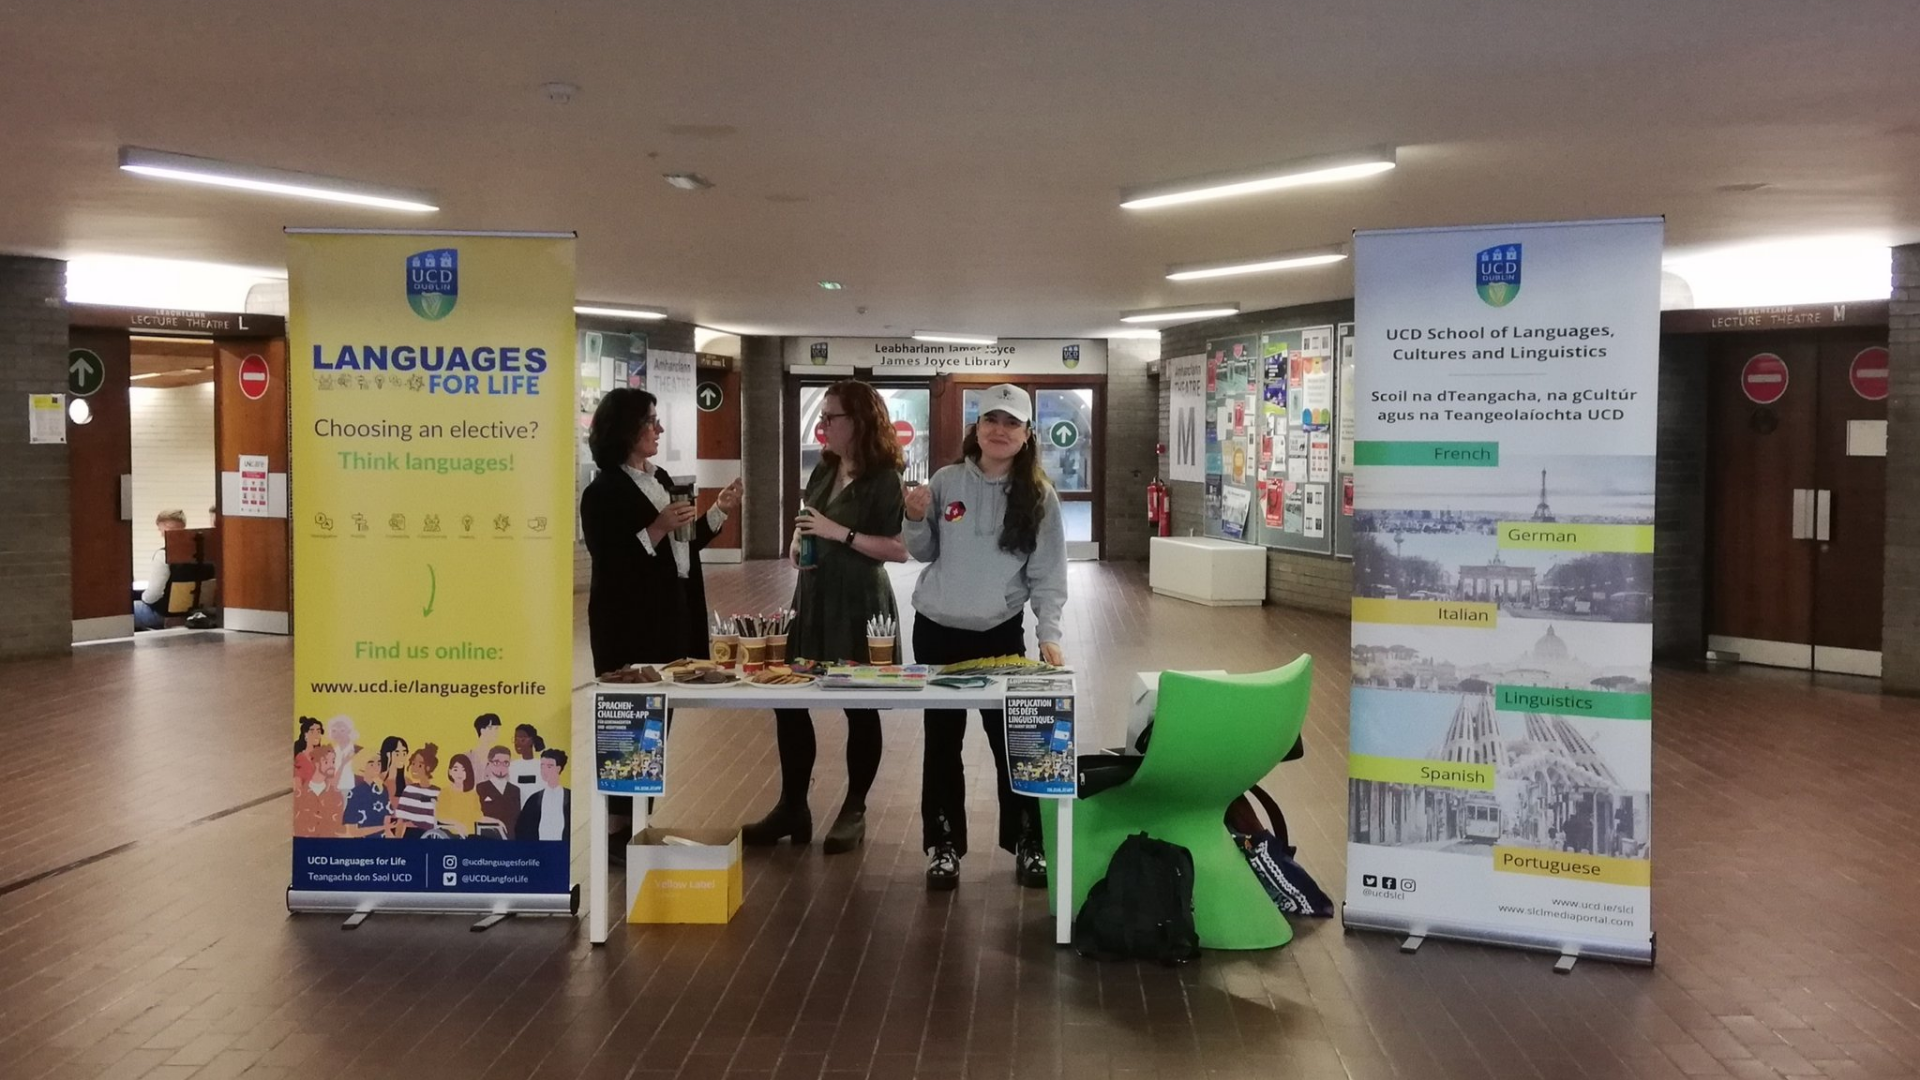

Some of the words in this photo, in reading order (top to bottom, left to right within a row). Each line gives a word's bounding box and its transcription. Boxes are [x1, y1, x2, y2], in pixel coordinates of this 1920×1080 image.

[1481, 262, 1517, 274] UCD
[412, 269, 452, 283] UCD
[131, 315, 178, 326] LECTURE
[186, 318, 230, 330] THEATRE
[238, 316, 249, 330] L
[1712, 316, 1761, 328] LECTURE
[1770, 313, 1821, 325] THEATRE
[1833, 305, 1845, 322] M
[1386, 329, 1422, 340] UCD
[1427, 328, 1485, 340] School
[1490, 327, 1508, 339] of
[1513, 326, 1615, 342] Languages,
[875, 344, 944, 354] Leabharlann
[1393, 348, 1466, 360] Cultures
[1472, 347, 1505, 360] and
[1511, 346, 1607, 362] Linguistics
[313, 345, 547, 373] LANGUAGES
[880, 356, 920, 366] James
[924, 356, 960, 368] Joyce
[964, 356, 1011, 368] Library
[429, 374, 479, 394] FOR
[488, 375, 540, 395] LIFE
[1371, 390, 1407, 402] Scoil
[1413, 392, 1432, 402] na
[1437, 390, 1541, 404] dTeangacha,
[1547, 391, 1567, 401] na
[1573, 388, 1637, 404] gCultúr
[1378, 411, 1415, 423] agus
[1420, 411, 1439, 421] na
[1445, 409, 1582, 423] Teangeolaíochta
[1588, 409, 1624, 420] UCD
[314, 419, 413, 441] Choosing
[419, 425, 443, 438] an
[450, 420, 539, 439] elective?
[1176, 407, 1195, 466] M
[1434, 447, 1491, 461] French
[338, 451, 400, 470] Think
[406, 453, 514, 474] languages!
[1508, 528, 1577, 543] German
[1438, 608, 1489, 622] Italian
[355, 641, 400, 659] Find
[407, 645, 429, 659] us
[435, 642, 503, 660] online:
[311, 680, 546, 698] www.ucd.ie/languagesforlife
[597, 701, 634, 710] SPRACHEN-
[1504, 692, 1593, 710] Linguistics
[597, 710, 650, 719] CHALLENGE-APP
[1008, 715, 1055, 724] LINGUISTIQUES
[1420, 766, 1486, 784] Spanish
[307, 856, 328, 866] UCD
[329, 857, 375, 868] Languages
[376, 857, 389, 866] for
[390, 857, 406, 867] Life
[461, 858, 540, 869] @ucdlanguagesforlife
[1503, 853, 1601, 876] Portuguese
[307, 872, 352, 883] Teangacha
[354, 873, 370, 882] don
[392, 873, 412, 883] UCD
[461, 874, 529, 885] @UCDLangforLife
[654, 880, 688, 889] Yellow
[689, 880, 715, 889] Label
[1552, 898, 1634, 914] www.ucd.ie/slcl
[1498, 903, 1634, 928] www.slclmediaportal.com
